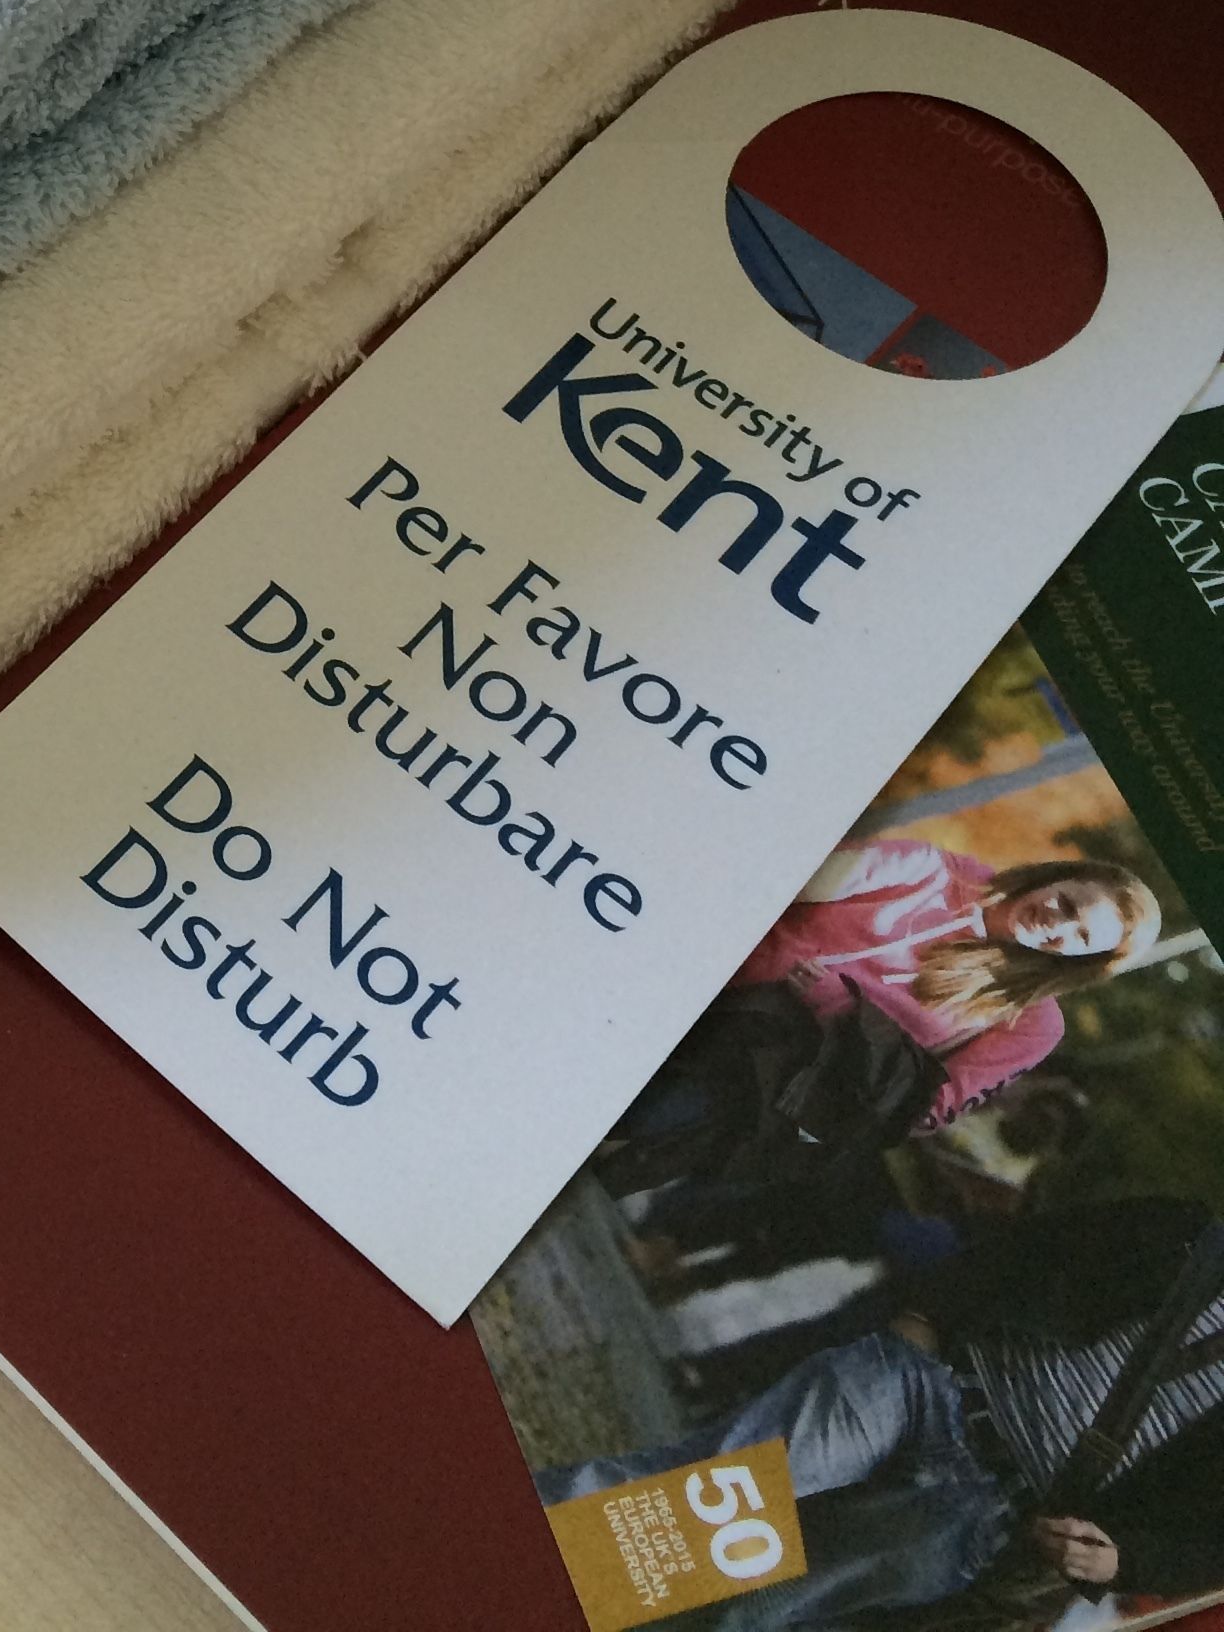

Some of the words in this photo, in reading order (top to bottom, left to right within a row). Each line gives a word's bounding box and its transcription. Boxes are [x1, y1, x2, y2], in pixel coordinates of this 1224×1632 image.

[501, 331, 868, 626] Kent
[589, 296, 843, 484] University
[844, 475, 921, 523] of
[345, 455, 486, 574] Per
[486, 560, 769, 792] Favore
[398, 601, 579, 769] Non
[1080, 590, 1133, 652] reach
[1121, 658, 1157, 695] the
[225, 580, 644, 934] Disturbare
[1074, 650, 1126, 704] your
[1151, 763, 1224, 853] around
[79, 825, 380, 1108] Disturb
[146, 754, 273, 882] Do
[281, 866, 463, 1041] Not
[603, 1500, 657, 1608] UNIVERSITY
[618, 1495, 671, 1599] EUROPEAN
[635, 1490, 659, 1529] THE
[651, 1487, 697, 1574] 1965-2015
[684, 1464, 784, 1580] 50
